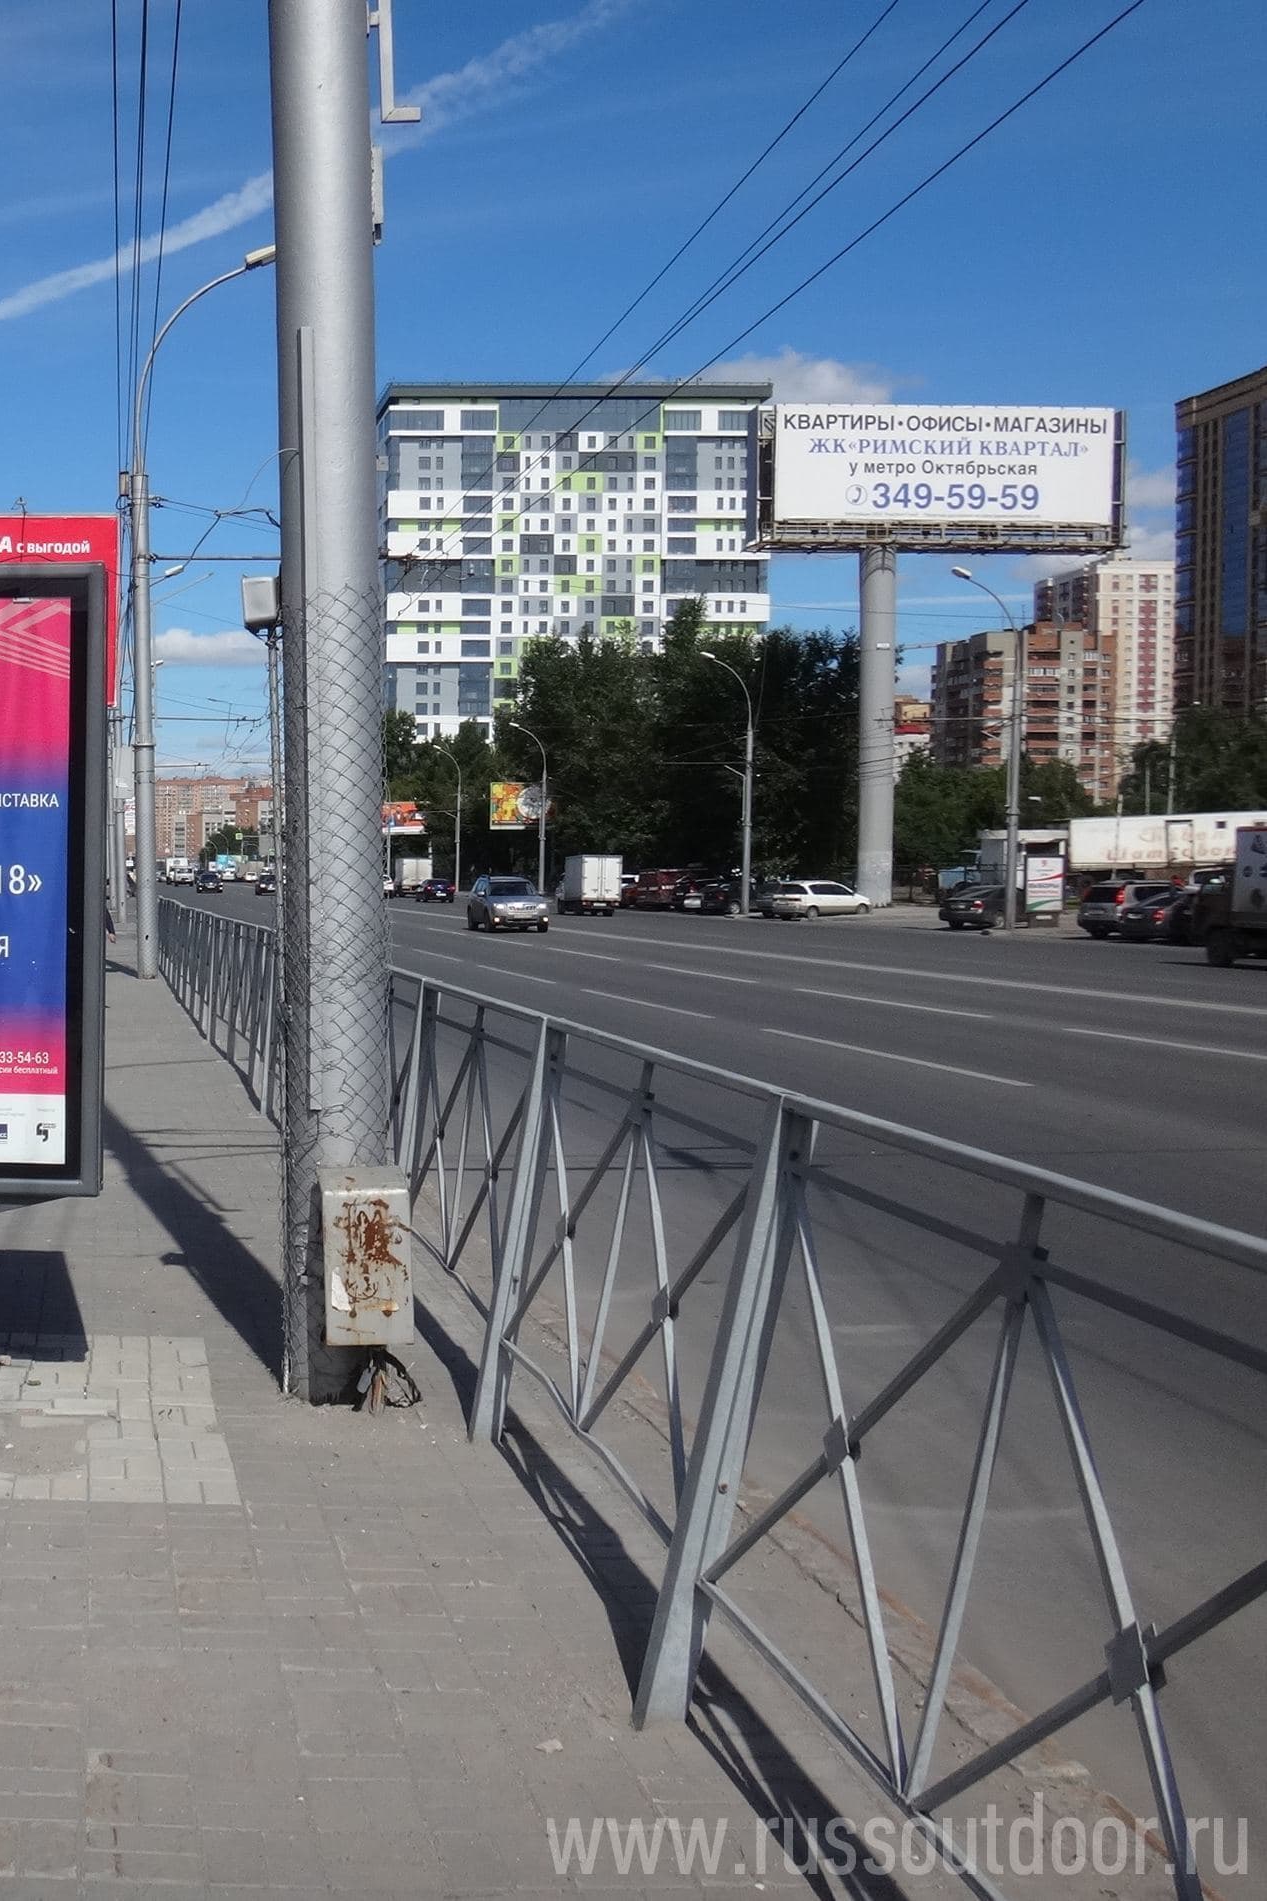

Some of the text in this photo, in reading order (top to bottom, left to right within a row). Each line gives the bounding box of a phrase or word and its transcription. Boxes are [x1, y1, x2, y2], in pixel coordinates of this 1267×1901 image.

[784, 414, 1107, 434] КВАРТИРЫ ОФИСЫ МАГАЗИНЫ
[849, 460, 1038, 477] у метро Октябрьская
[872, 483, 1040, 510] 349-59-59
[27, 540, 91, 556] выгодой
[13, 1066, 58, 1074] бесплатный
